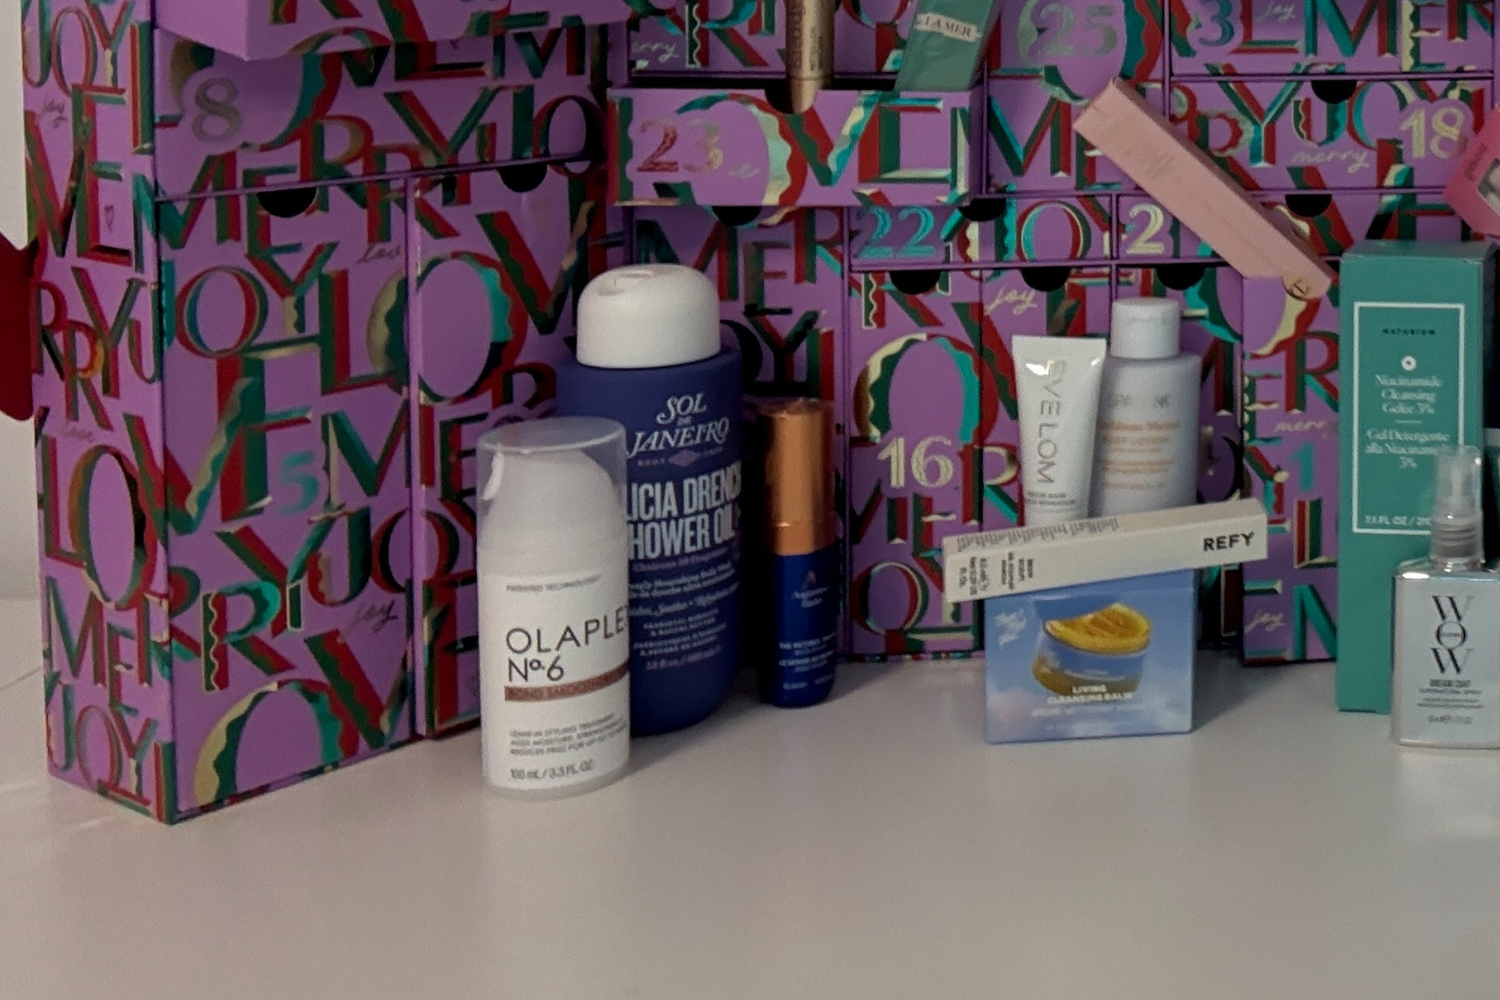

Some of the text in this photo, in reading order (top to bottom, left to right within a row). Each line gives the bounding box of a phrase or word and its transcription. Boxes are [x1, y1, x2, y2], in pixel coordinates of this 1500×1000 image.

[944, 20, 972, 38] MER
[1040, 2, 1119, 57] 25
[191, 75, 242, 143] 8
[1400, 106, 1466, 160] 18
[636, 116, 724, 174] 23
[1289, 149, 1371, 174] merry
[857, 204, 935, 259] 22
[1128, 203, 1165, 256] 2
[984, 284, 1038, 316] joy
[656, 391, 708, 425] SOL
[1039, 360, 1067, 416] EYE
[1381, 389, 1436, 404] Cleansing
[626, 416, 731, 460] JANEIRO
[876, 435, 956, 490] 16
[1036, 423, 1059, 484] LOM
[277, 452, 321, 514] 5
[1288, 440, 1315, 493] 1
[627, 503, 736, 560] HOWER OIL
[1203, 531, 1255, 552] REFY
[505, 604, 630, 655] OLAPLE
